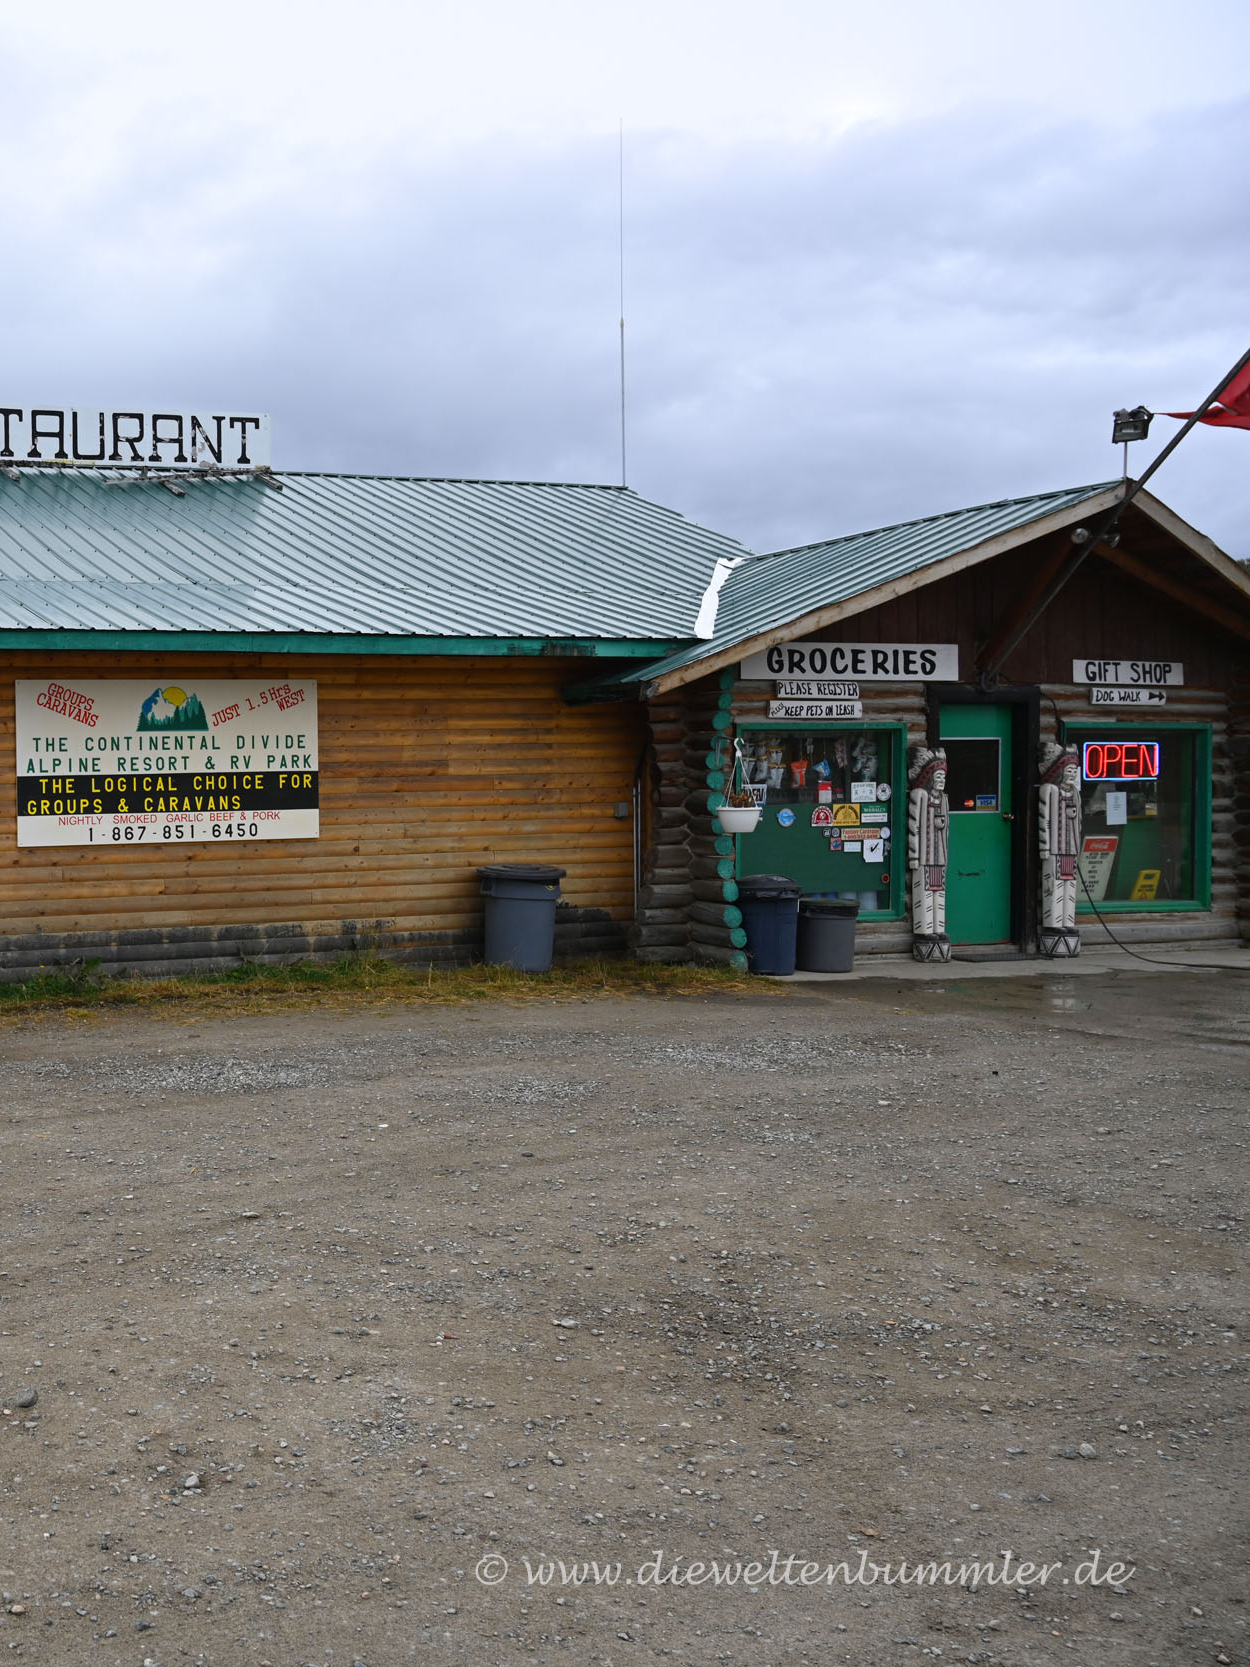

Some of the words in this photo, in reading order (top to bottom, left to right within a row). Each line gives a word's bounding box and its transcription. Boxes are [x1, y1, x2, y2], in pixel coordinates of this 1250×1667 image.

[766, 646, 937, 676] GROCERIES
[1085, 661, 1121, 682] GIFT
[1130, 662, 1172, 684] SHOP
[47, 682, 95, 712] GROUPS
[777, 681, 813, 696] PLEASE
[816, 682, 858, 697] REGISTER
[1095, 689, 1115, 703] DOG
[1118, 690, 1141, 702] WALK
[36, 692, 99, 728] CARAVANS
[276, 689, 306, 712] WEST
[784, 704, 805, 717] KEEP
[805, 704, 824, 717] PETS
[825, 704, 834, 716] ON
[836, 703, 855, 716] LEASH
[211, 703, 241, 727] JUST
[32, 737, 68, 753] THE
[84, 735, 221, 752] CONTINENTAL
[236, 734, 307, 750] DIVIDE
[26, 757, 102, 774] ALPINE
[116, 755, 190, 772] RESORT
[204, 755, 216, 770] &
[230, 754, 252, 770] RV
[267, 753, 312, 769] PARK
[1085, 743, 1159, 779] OPEN
[39, 778, 76, 795] THE
[91, 776, 178, 793] LOGICAL
[192, 774, 264, 791] CHOICE
[279, 773, 313, 789] FOR
[27, 798, 103, 815] GROUPS
[117, 797, 129, 813] &
[144, 794, 242, 812] CARAVANS
[58, 815, 103, 826] NIGHTLY
[112, 814, 158, 824] SMOKED
[165, 812, 204, 823] GARLIC
[209, 812, 234, 822] BEEF
[239, 811, 247, 821] &
[252, 811, 281, 820] PORK
